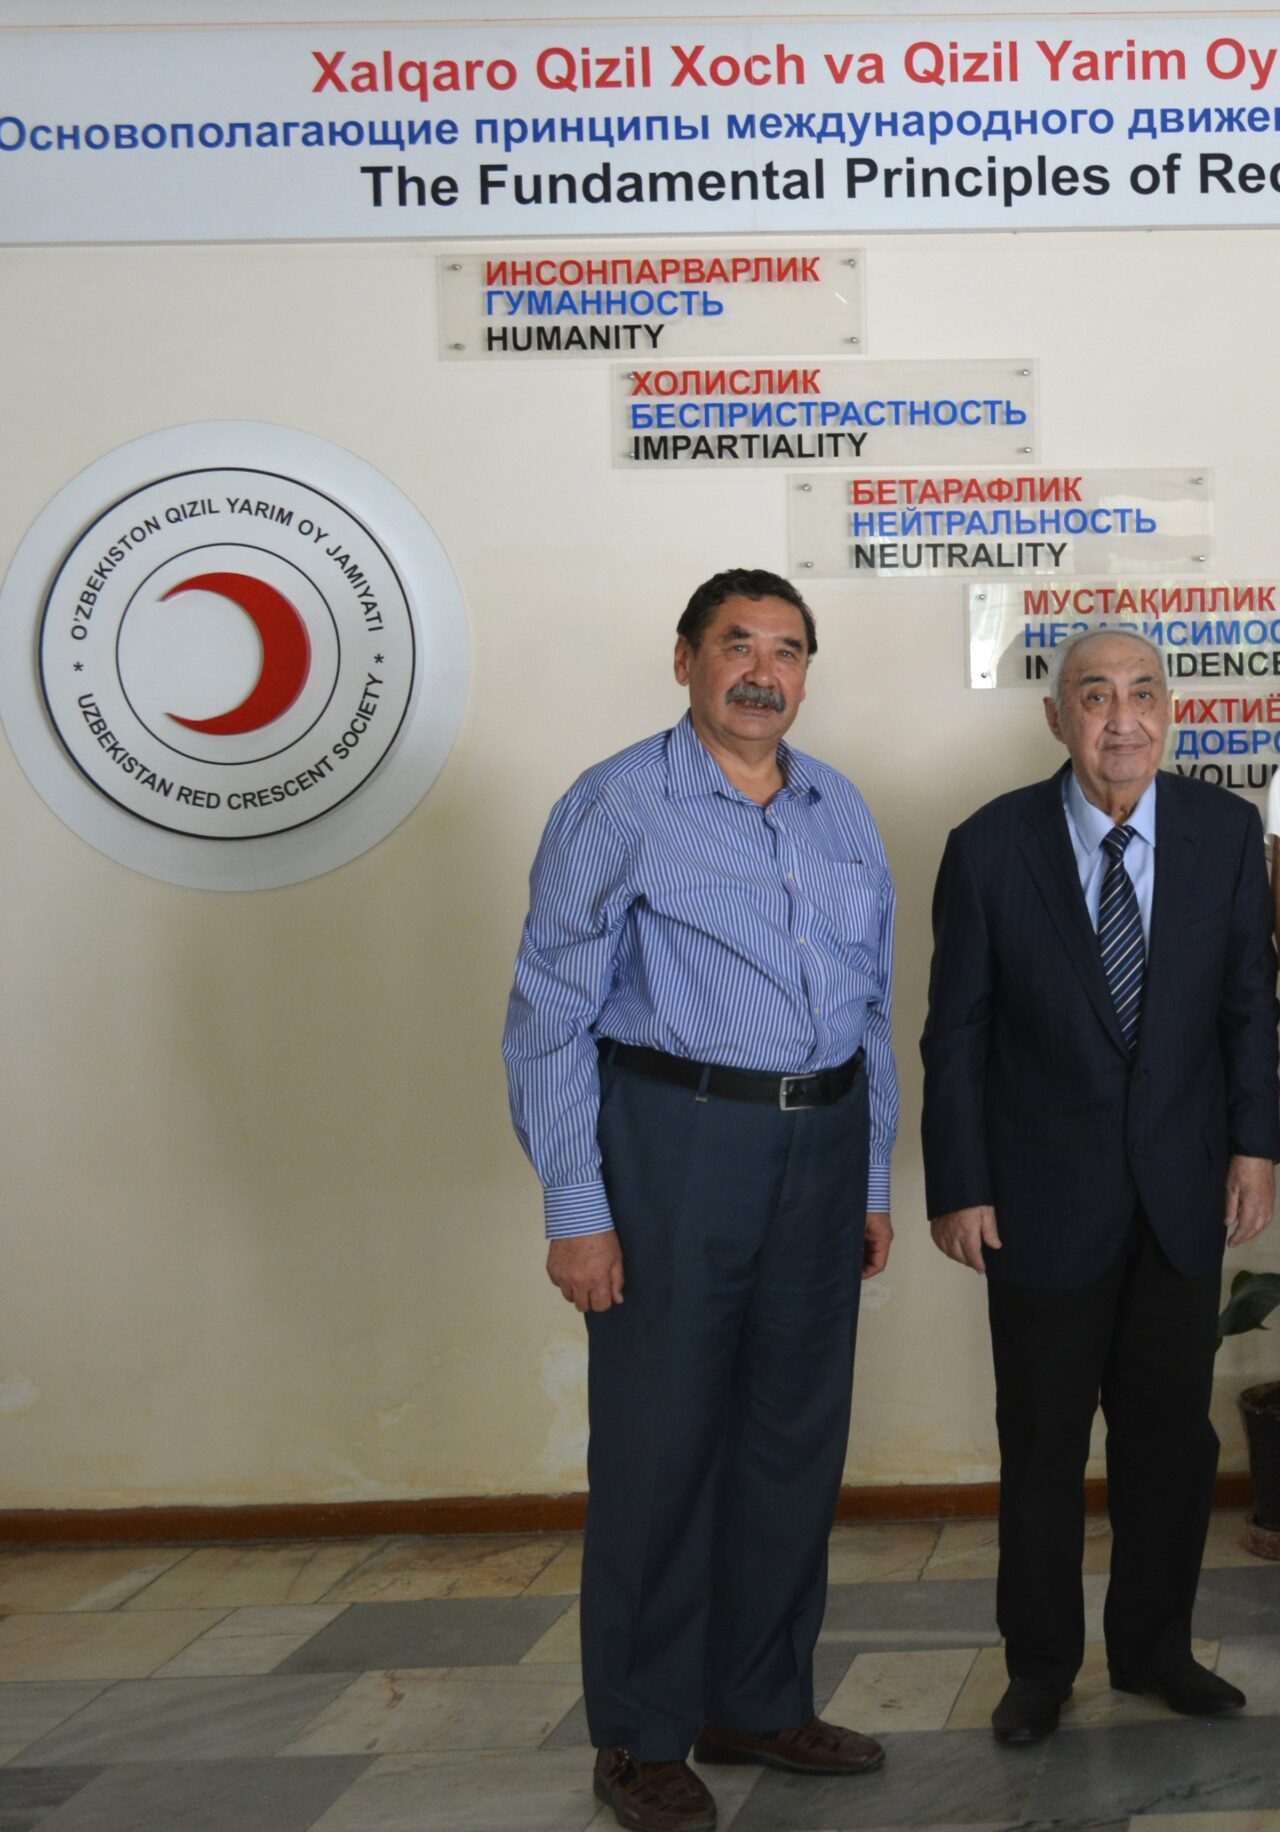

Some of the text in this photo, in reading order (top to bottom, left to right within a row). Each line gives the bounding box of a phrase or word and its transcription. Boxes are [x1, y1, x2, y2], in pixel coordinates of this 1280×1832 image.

[312, 49, 518, 103] Xalqaro
[535, 45, 652, 93] Qizil
[671, 42, 806, 88] Xoch
[824, 51, 885, 85] va
[903, 39, 1019, 86] Qizil
[1036, 38, 1187, 82] Yarim
[1205, 36, 1278, 91] Oy
[0, 116, 460, 153] Основополагающие
[475, 114, 711, 153] принципы
[726, 107, 1115, 149] международного
[360, 165, 459, 207] The
[479, 158, 824, 205] Fundamental
[846, 155, 1110, 207] Principles
[1130, 152, 1182, 195] of
[485, 256, 822, 287] ИНСОНПАРВАРЛИК
[486, 289, 725, 318] ГУМАННОСТЬ
[487, 323, 665, 352] HUMANITY
[631, 368, 822, 398] ХОЛИСЛИК
[630, 399, 1029, 431] БЕСПРИСТРАСТНОСТЬ
[633, 432, 868, 461] IMPARTIALITY
[851, 475, 1084, 506] БЕТАРАФЛИК
[853, 506, 1158, 538] НЕЙТРАЛЬНОСТЬ
[165, 497, 221, 525] QIZIL
[225, 497, 295, 528] YARIM
[297, 518, 330, 545] OY
[325, 544, 385, 633] JAMIYATI
[854, 542, 1068, 569] NEUTRALITY
[1024, 585, 1277, 620] МУСТАҚИЛЛИК
[77, 673, 385, 811] UZBEKISTAN RED CRESCENT SOCIETY
